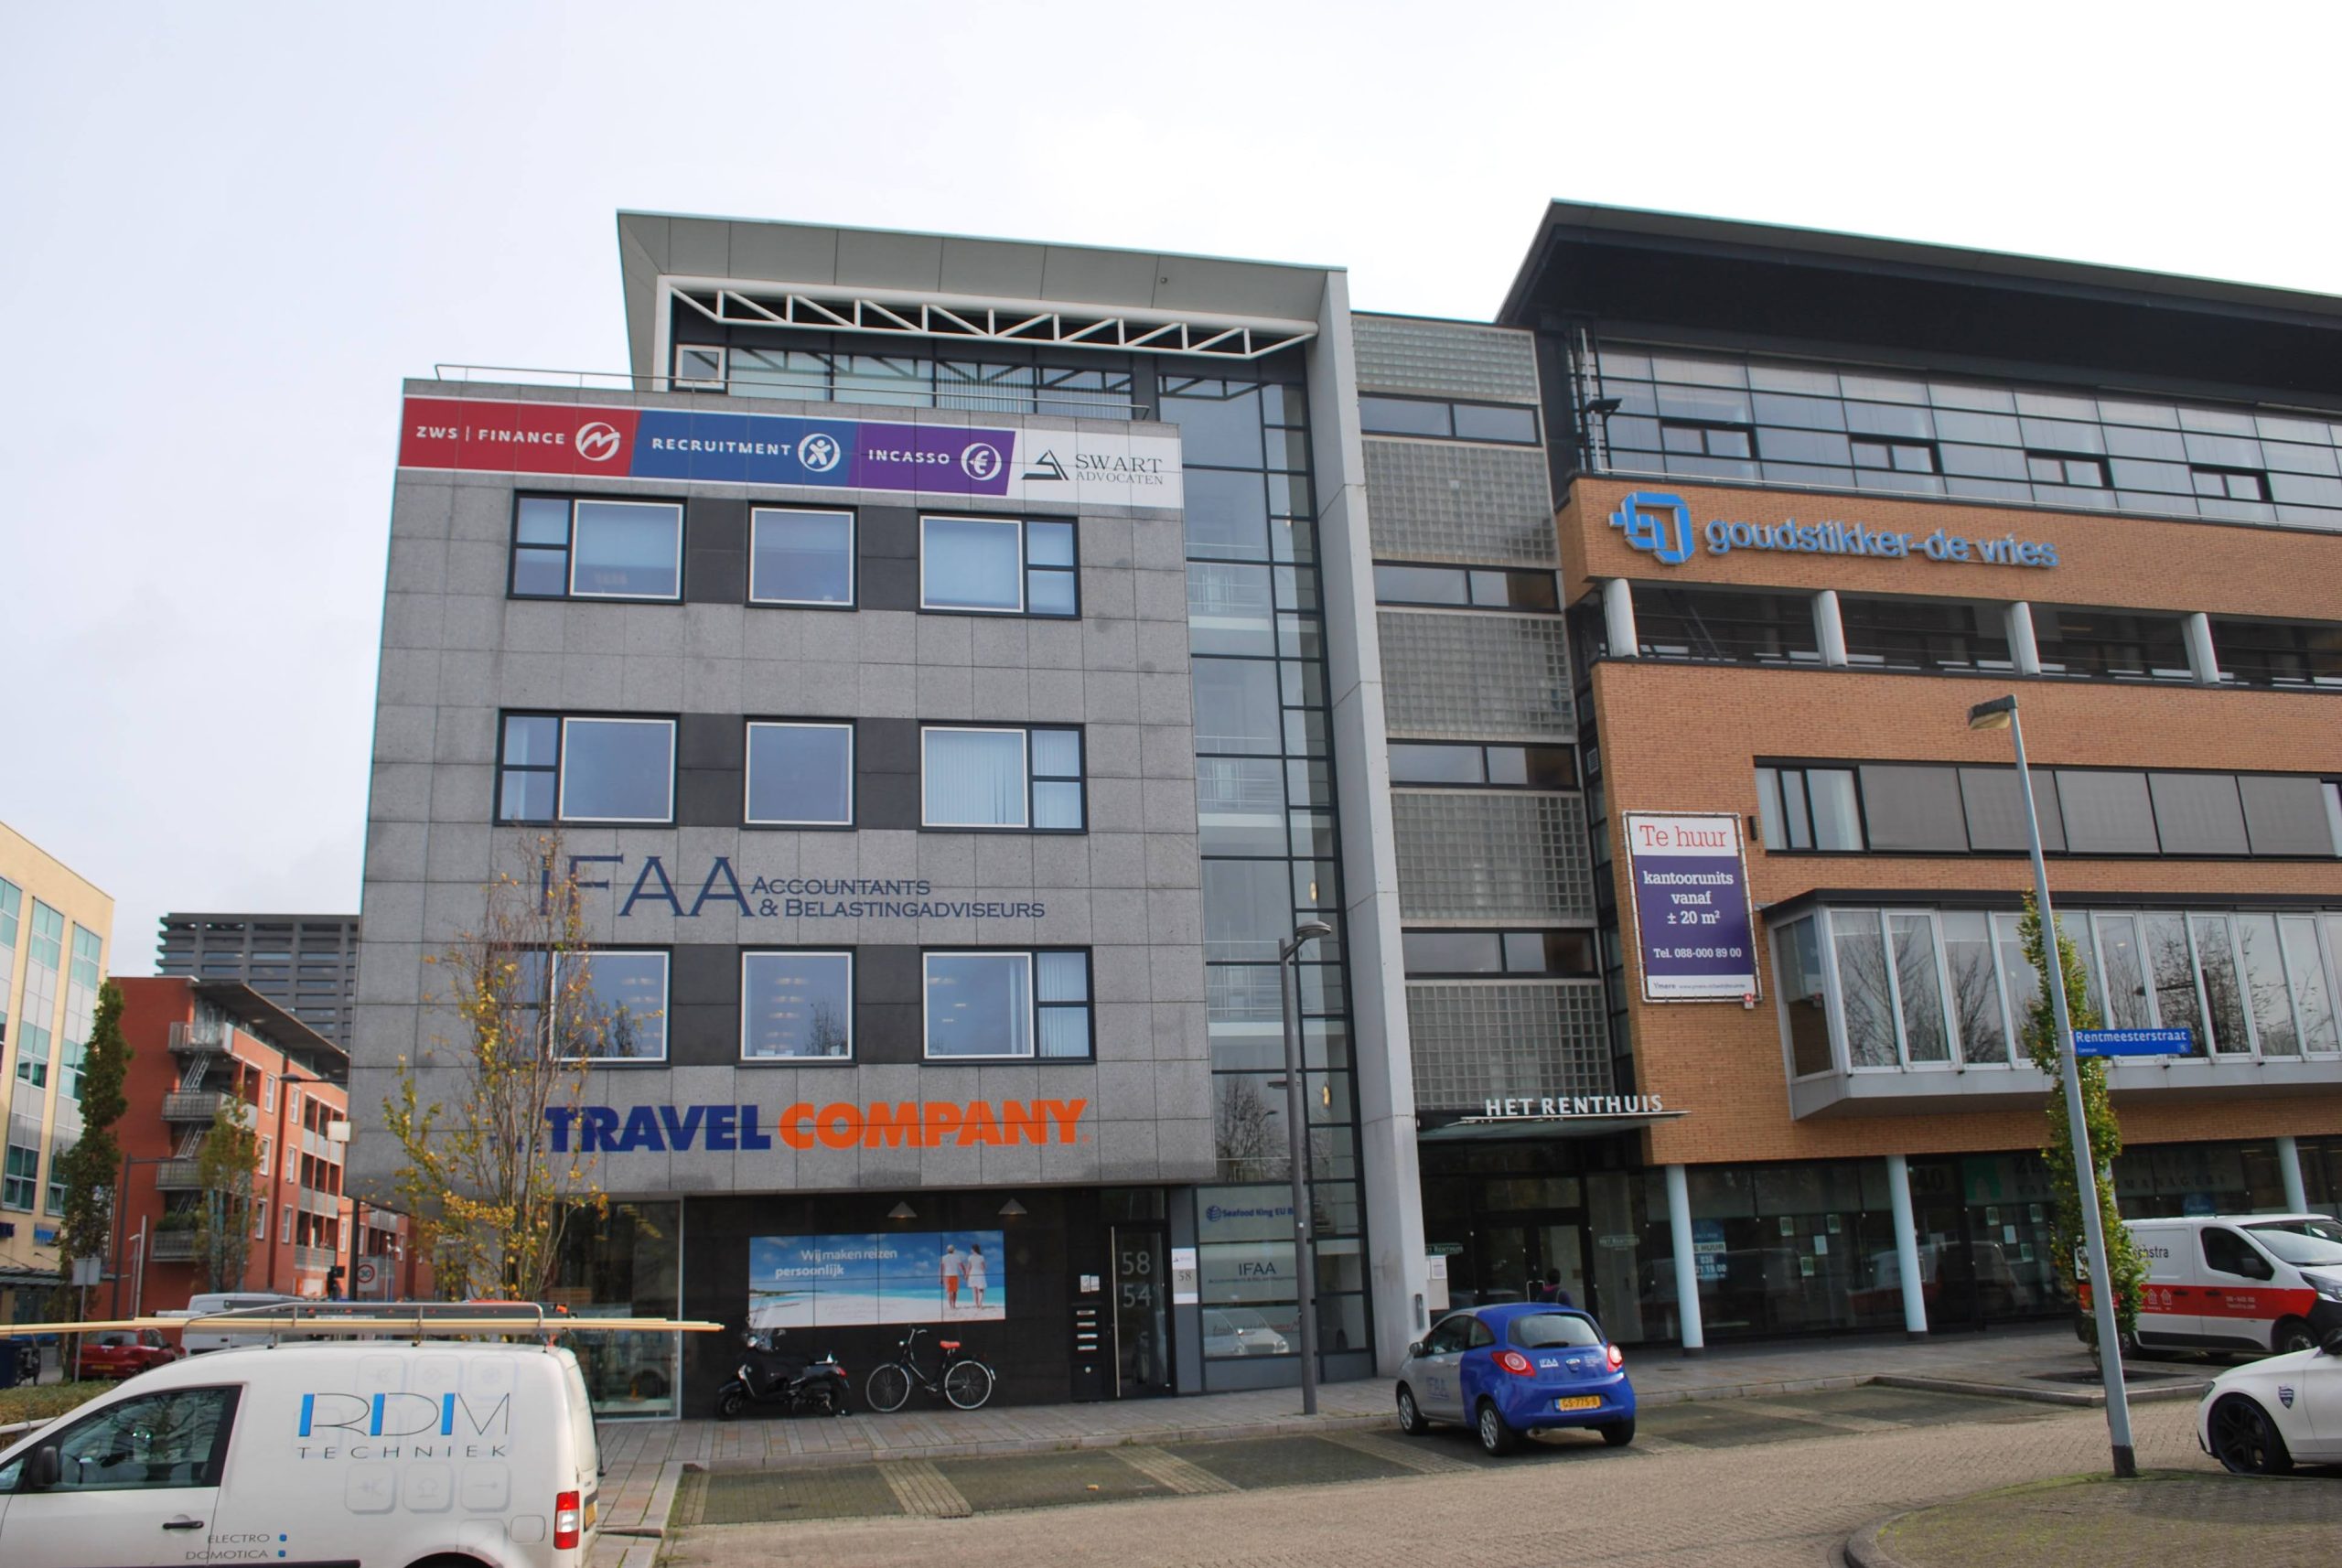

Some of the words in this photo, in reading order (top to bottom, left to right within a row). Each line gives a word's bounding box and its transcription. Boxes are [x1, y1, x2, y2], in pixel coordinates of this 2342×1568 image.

[416, 425, 457, 440] ZWS
[478, 428, 565, 446] FINANCE
[651, 437, 792, 456] RECRUITMENT
[868, 449, 951, 465] INCASSO
[1075, 453, 1164, 474] SWART
[1075, 470, 1164, 485] ADVOCATEN
[1977, 534, 2060, 568] vries
[1638, 824, 1669, 847] Te
[1674, 825, 1727, 848] huur
[539, 854, 757, 917] IFAA
[750, 875, 931, 896] ACCOUNTANTS
[1643, 870, 1734, 886] kantoorunits
[1671, 890, 1712, 905] vanaf
[759, 898, 779, 917] &
[785, 898, 1046, 918] BELASTINGADVISEURS
[1680, 910, 1698, 925] 20
[1653, 948, 1672, 959] Tel.
[1674, 948, 1714, 959] 088-000
[1715, 948, 1728, 958] 89
[1729, 948, 1742, 958] 00
[2076, 1031, 2187, 1043] Rentmeesterstraat
[1486, 1098, 1534, 1117] HET
[1541, 1095, 1663, 1115] RENTHUIS
[544, 1105, 771, 1152] TRAVEL
[779, 1099, 1088, 1149] COMPANY
[1223, 1208, 1254, 1217] Seafood
[1256, 1208, 1273, 1218] King
[1701, 1243, 1724, 1252] HUUR
[800, 1250, 822, 1263] Wij
[823, 1249, 862, 1261] maken
[864, 1249, 897, 1260] reizen
[1122, 1251, 1151, 1275] 58
[360, 1269, 371, 1278] 30
[775, 1264, 844, 1280] persoonlijk
[1178, 1270, 1192, 1282] 58
[1239, 1262, 1277, 1276] IFAA
[1123, 1283, 1152, 1308] 54
[298, 1392, 510, 1437] RDM
[297, 1444, 508, 1460] TECHNIEK
[208, 1533, 270, 1544] ELECTRO
[186, 1549, 269, 1560] DOMOTICA
